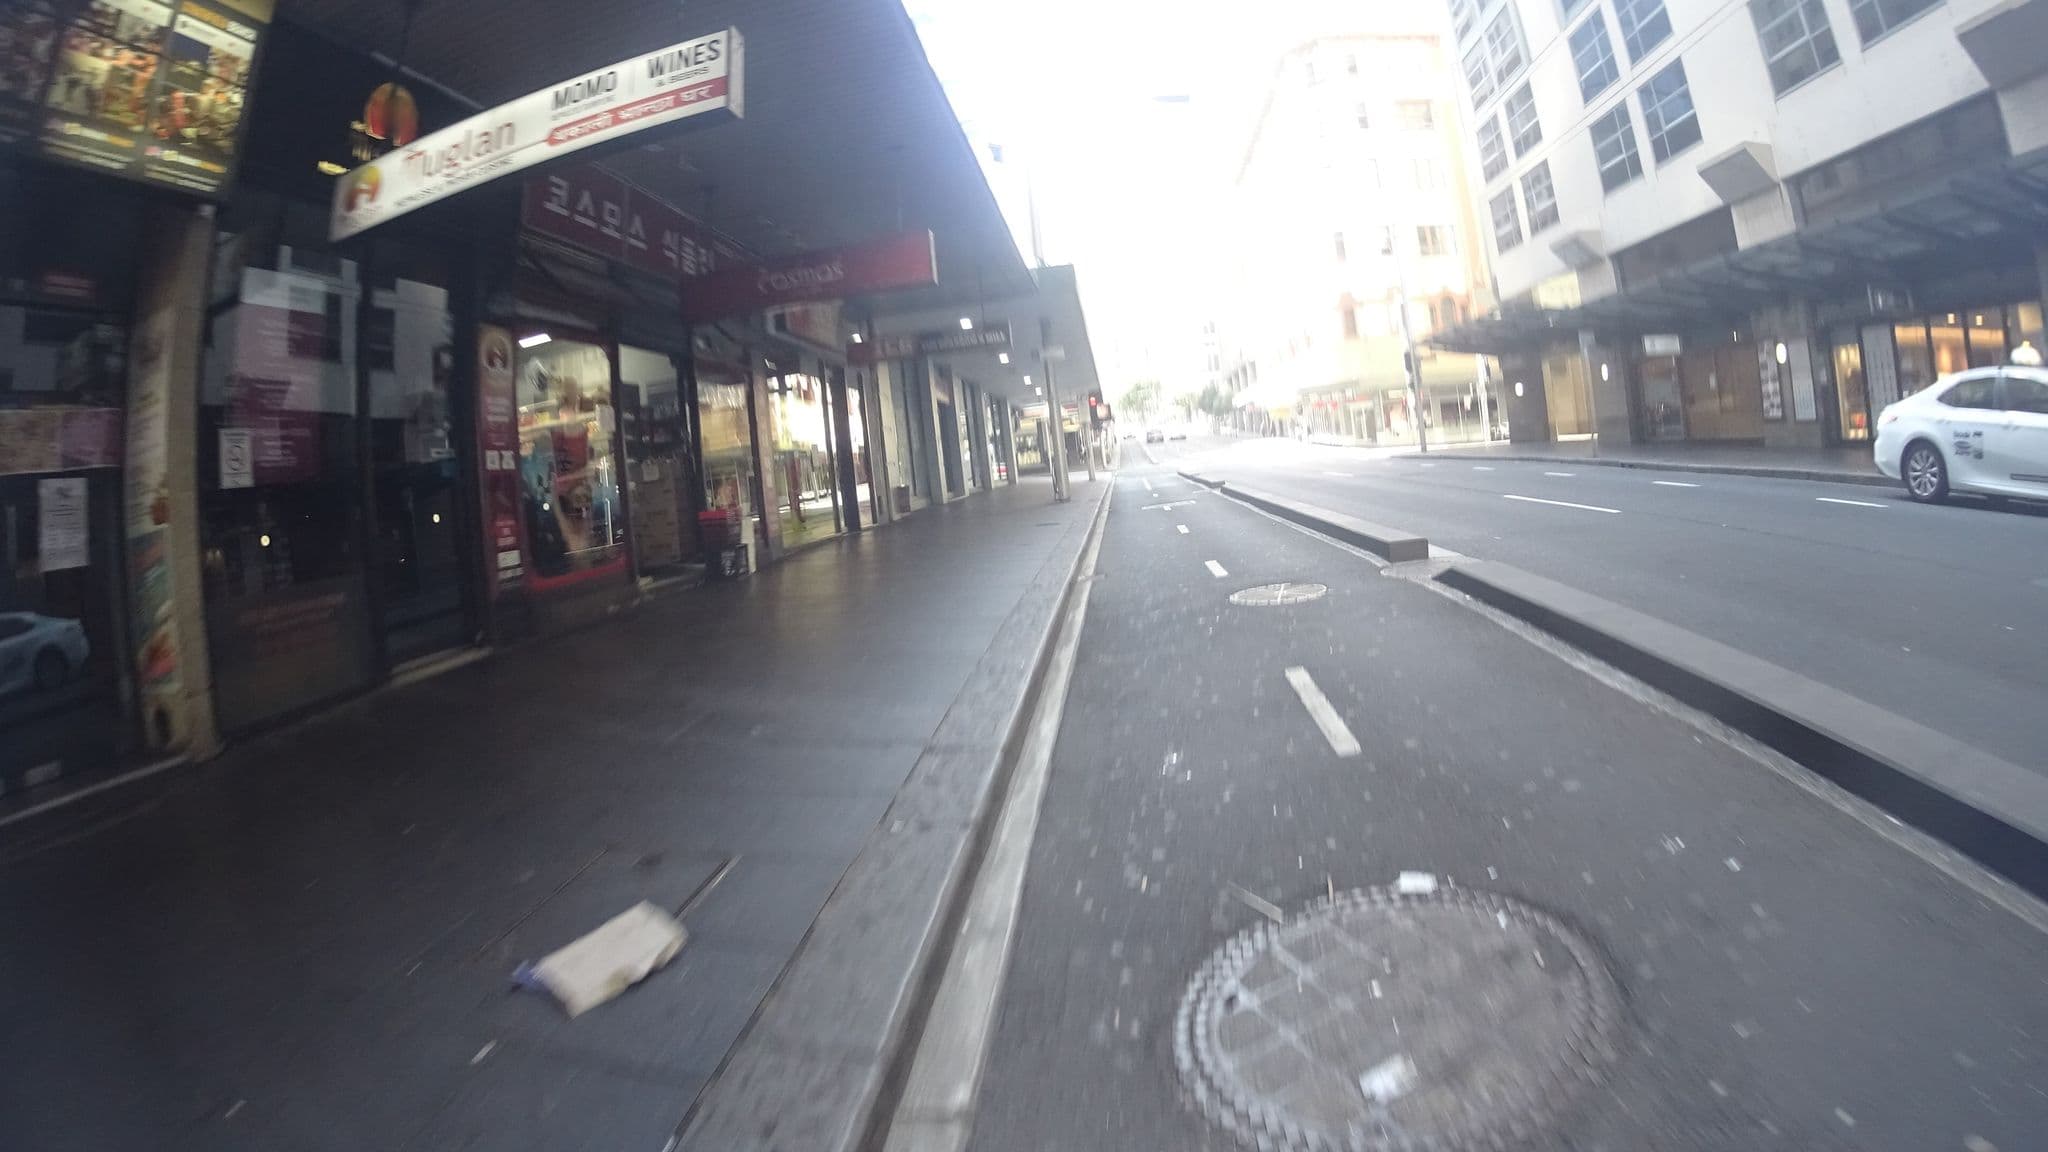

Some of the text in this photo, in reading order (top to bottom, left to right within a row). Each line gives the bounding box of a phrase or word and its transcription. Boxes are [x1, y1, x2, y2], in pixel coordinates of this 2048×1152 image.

[647, 39, 721, 79] WINES
[552, 71, 617, 110] MOMO
[543, 175, 648, 251] 코스모스
